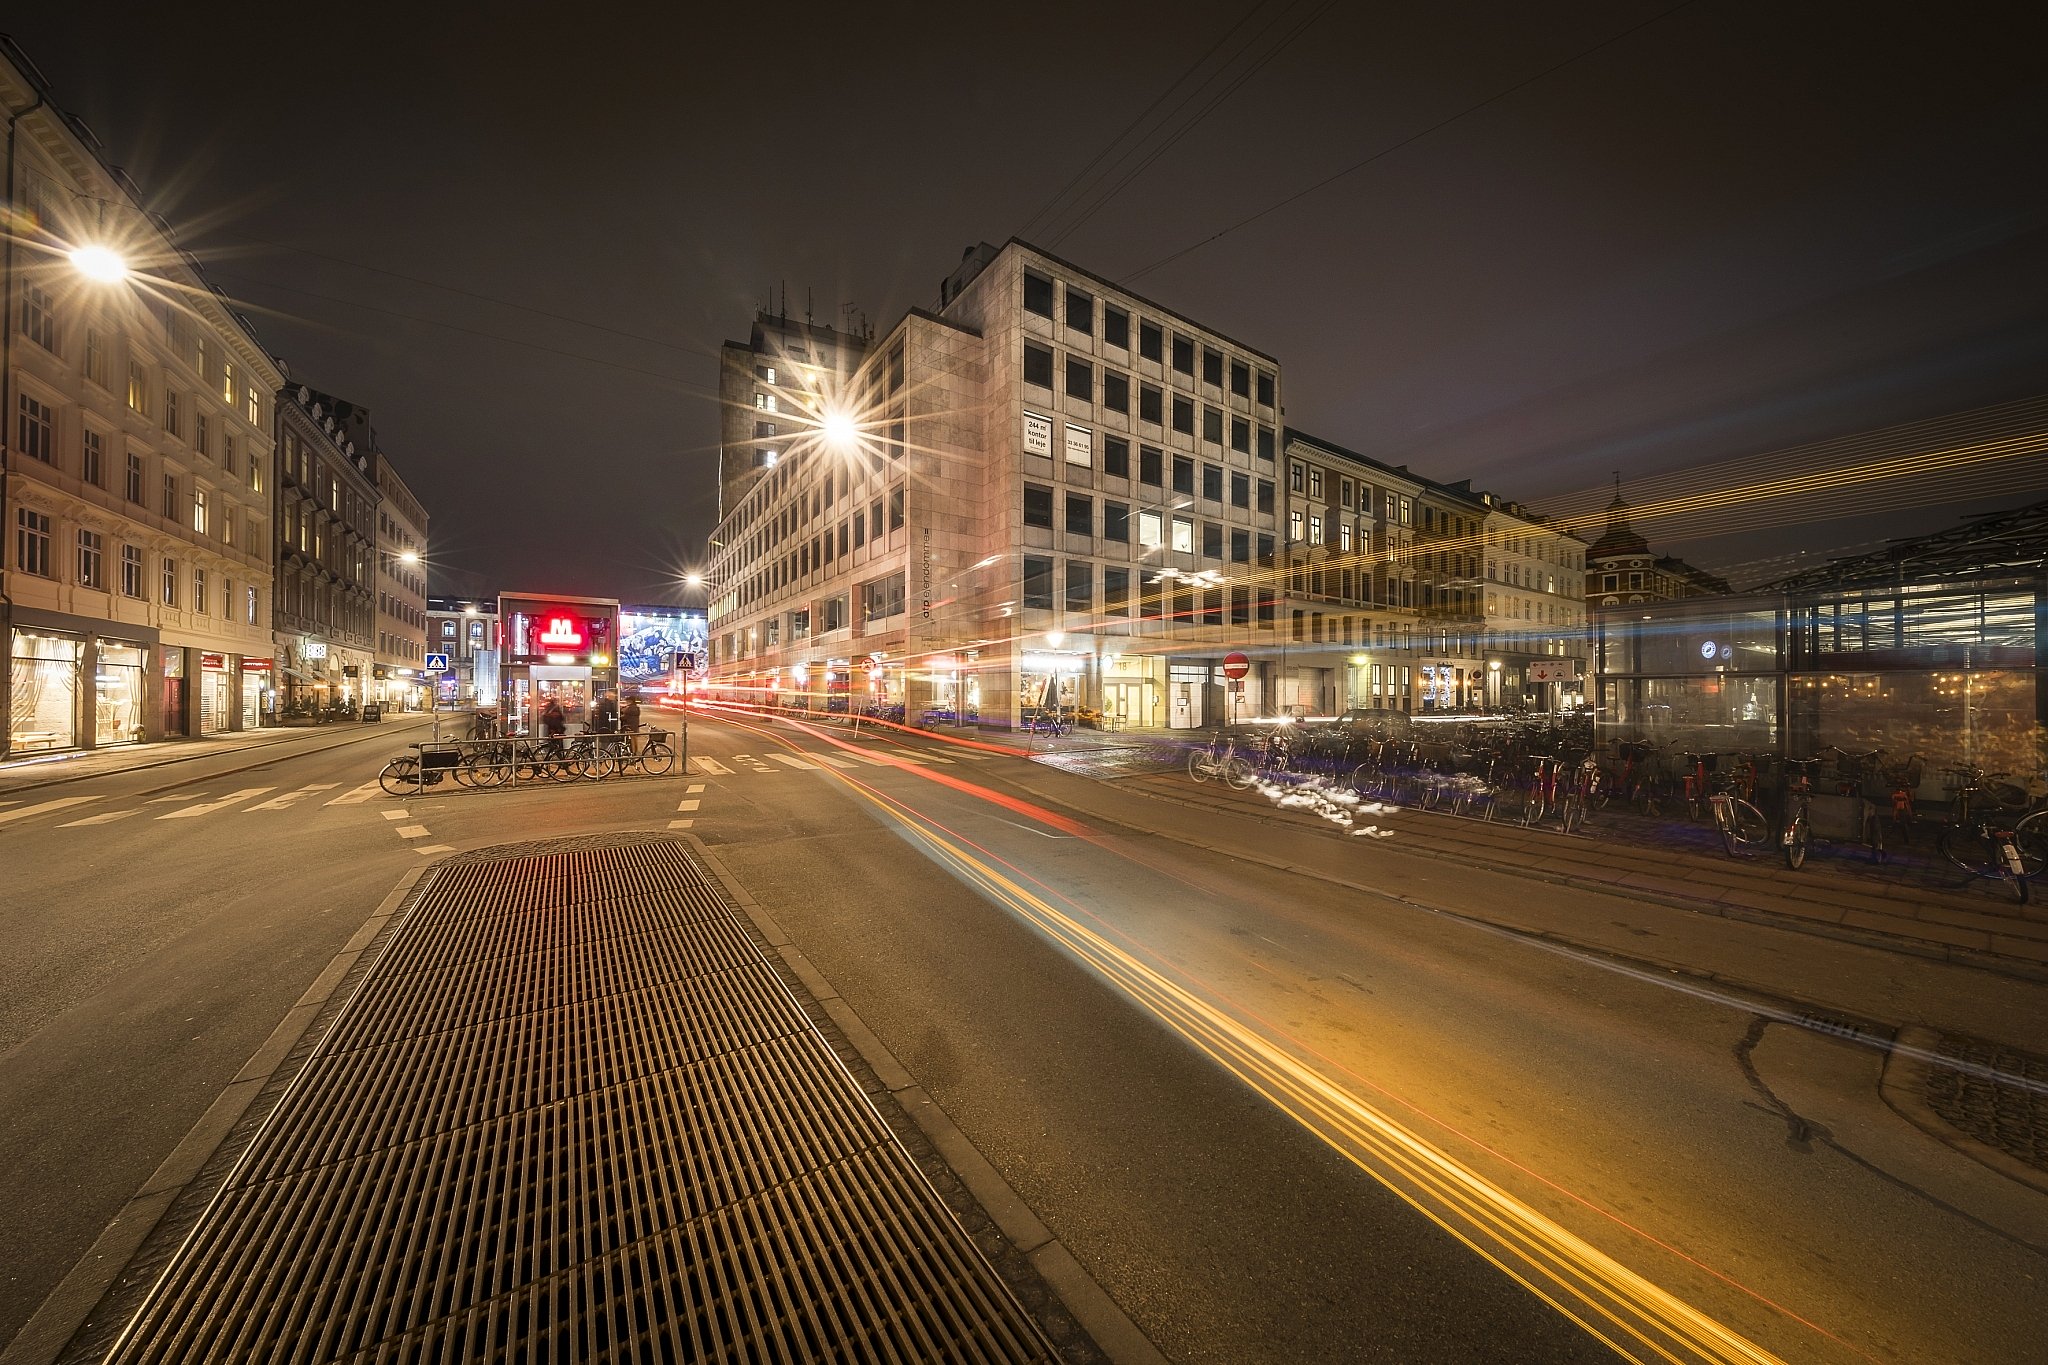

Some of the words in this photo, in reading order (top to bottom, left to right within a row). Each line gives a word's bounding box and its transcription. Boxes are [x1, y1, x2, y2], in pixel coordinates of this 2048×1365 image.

[1028, 429, 1046, 439] kontor
[1036, 439, 1046, 448] leje
[1119, 662, 1126, 671] 18
